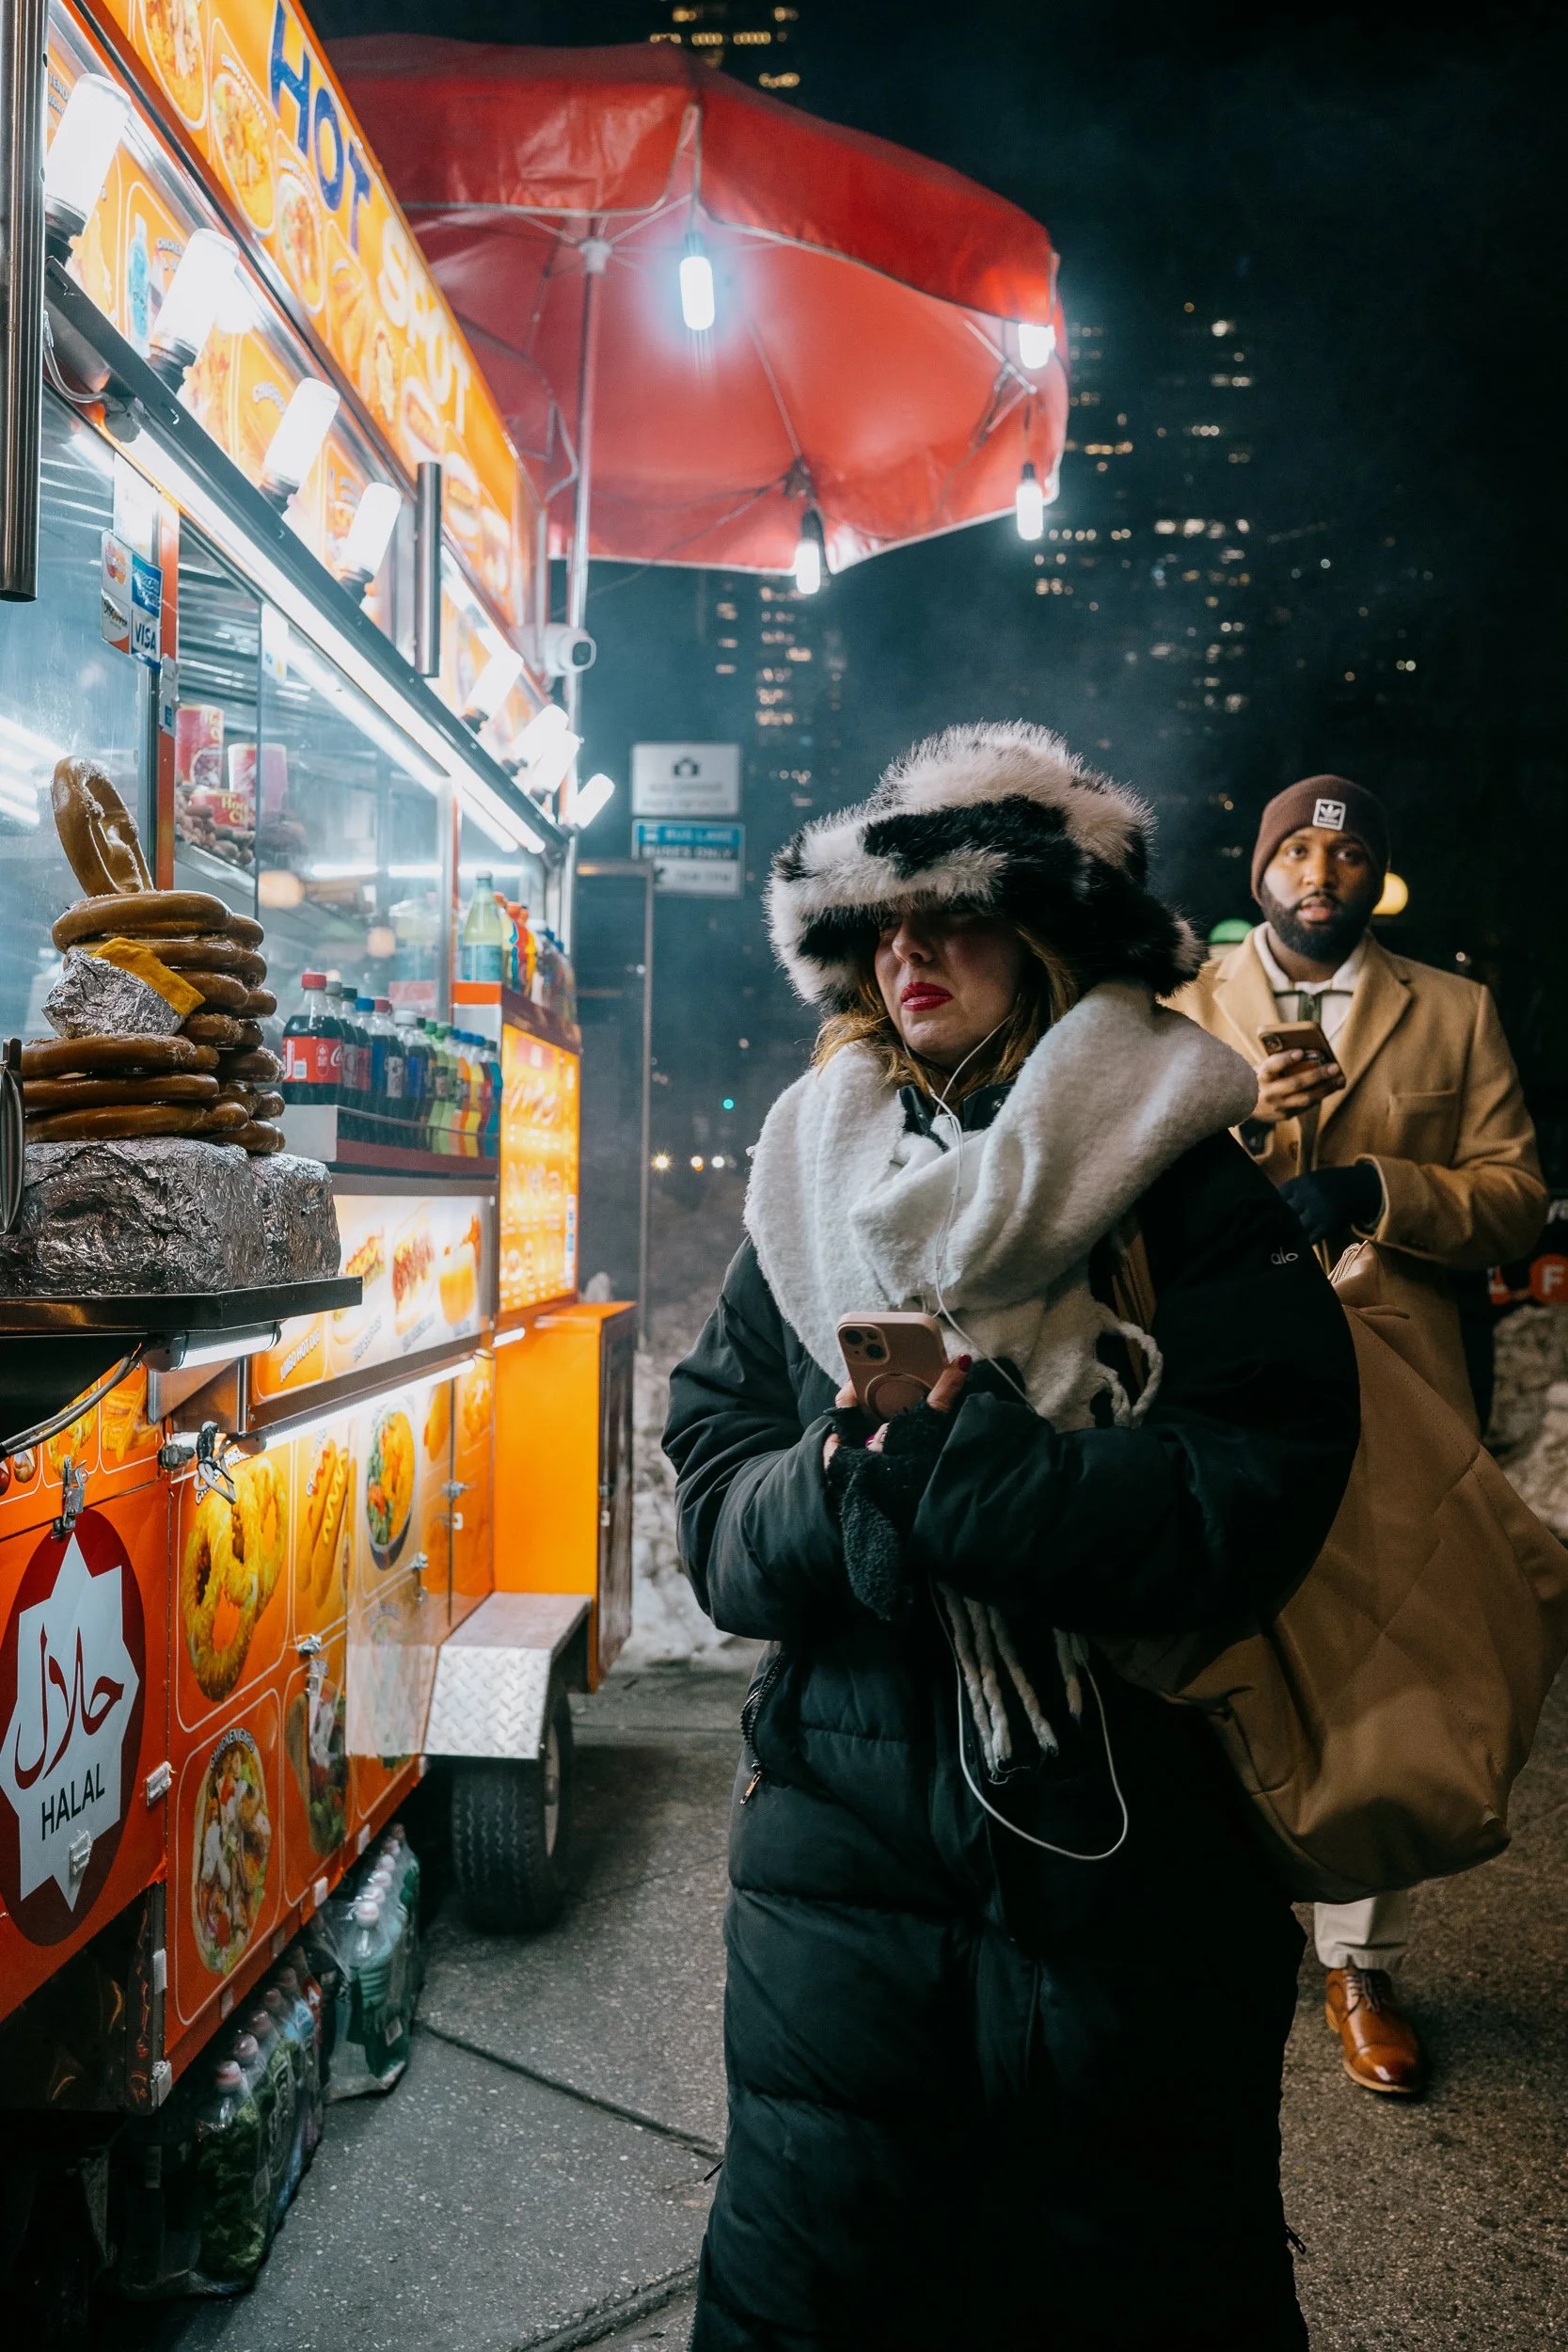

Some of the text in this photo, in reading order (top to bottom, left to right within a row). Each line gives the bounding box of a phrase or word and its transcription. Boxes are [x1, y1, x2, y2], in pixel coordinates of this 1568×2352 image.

[267, 0, 372, 256] HOT
[378, 215, 470, 434] SPOT
[135, 621, 157, 651] VISA
[1270, 1247, 1299, 1264] alo
[1543, 1264, 1564, 1295] F
[14, 1622, 125, 1790] حلال
[40, 1763, 105, 1841] HALAL
